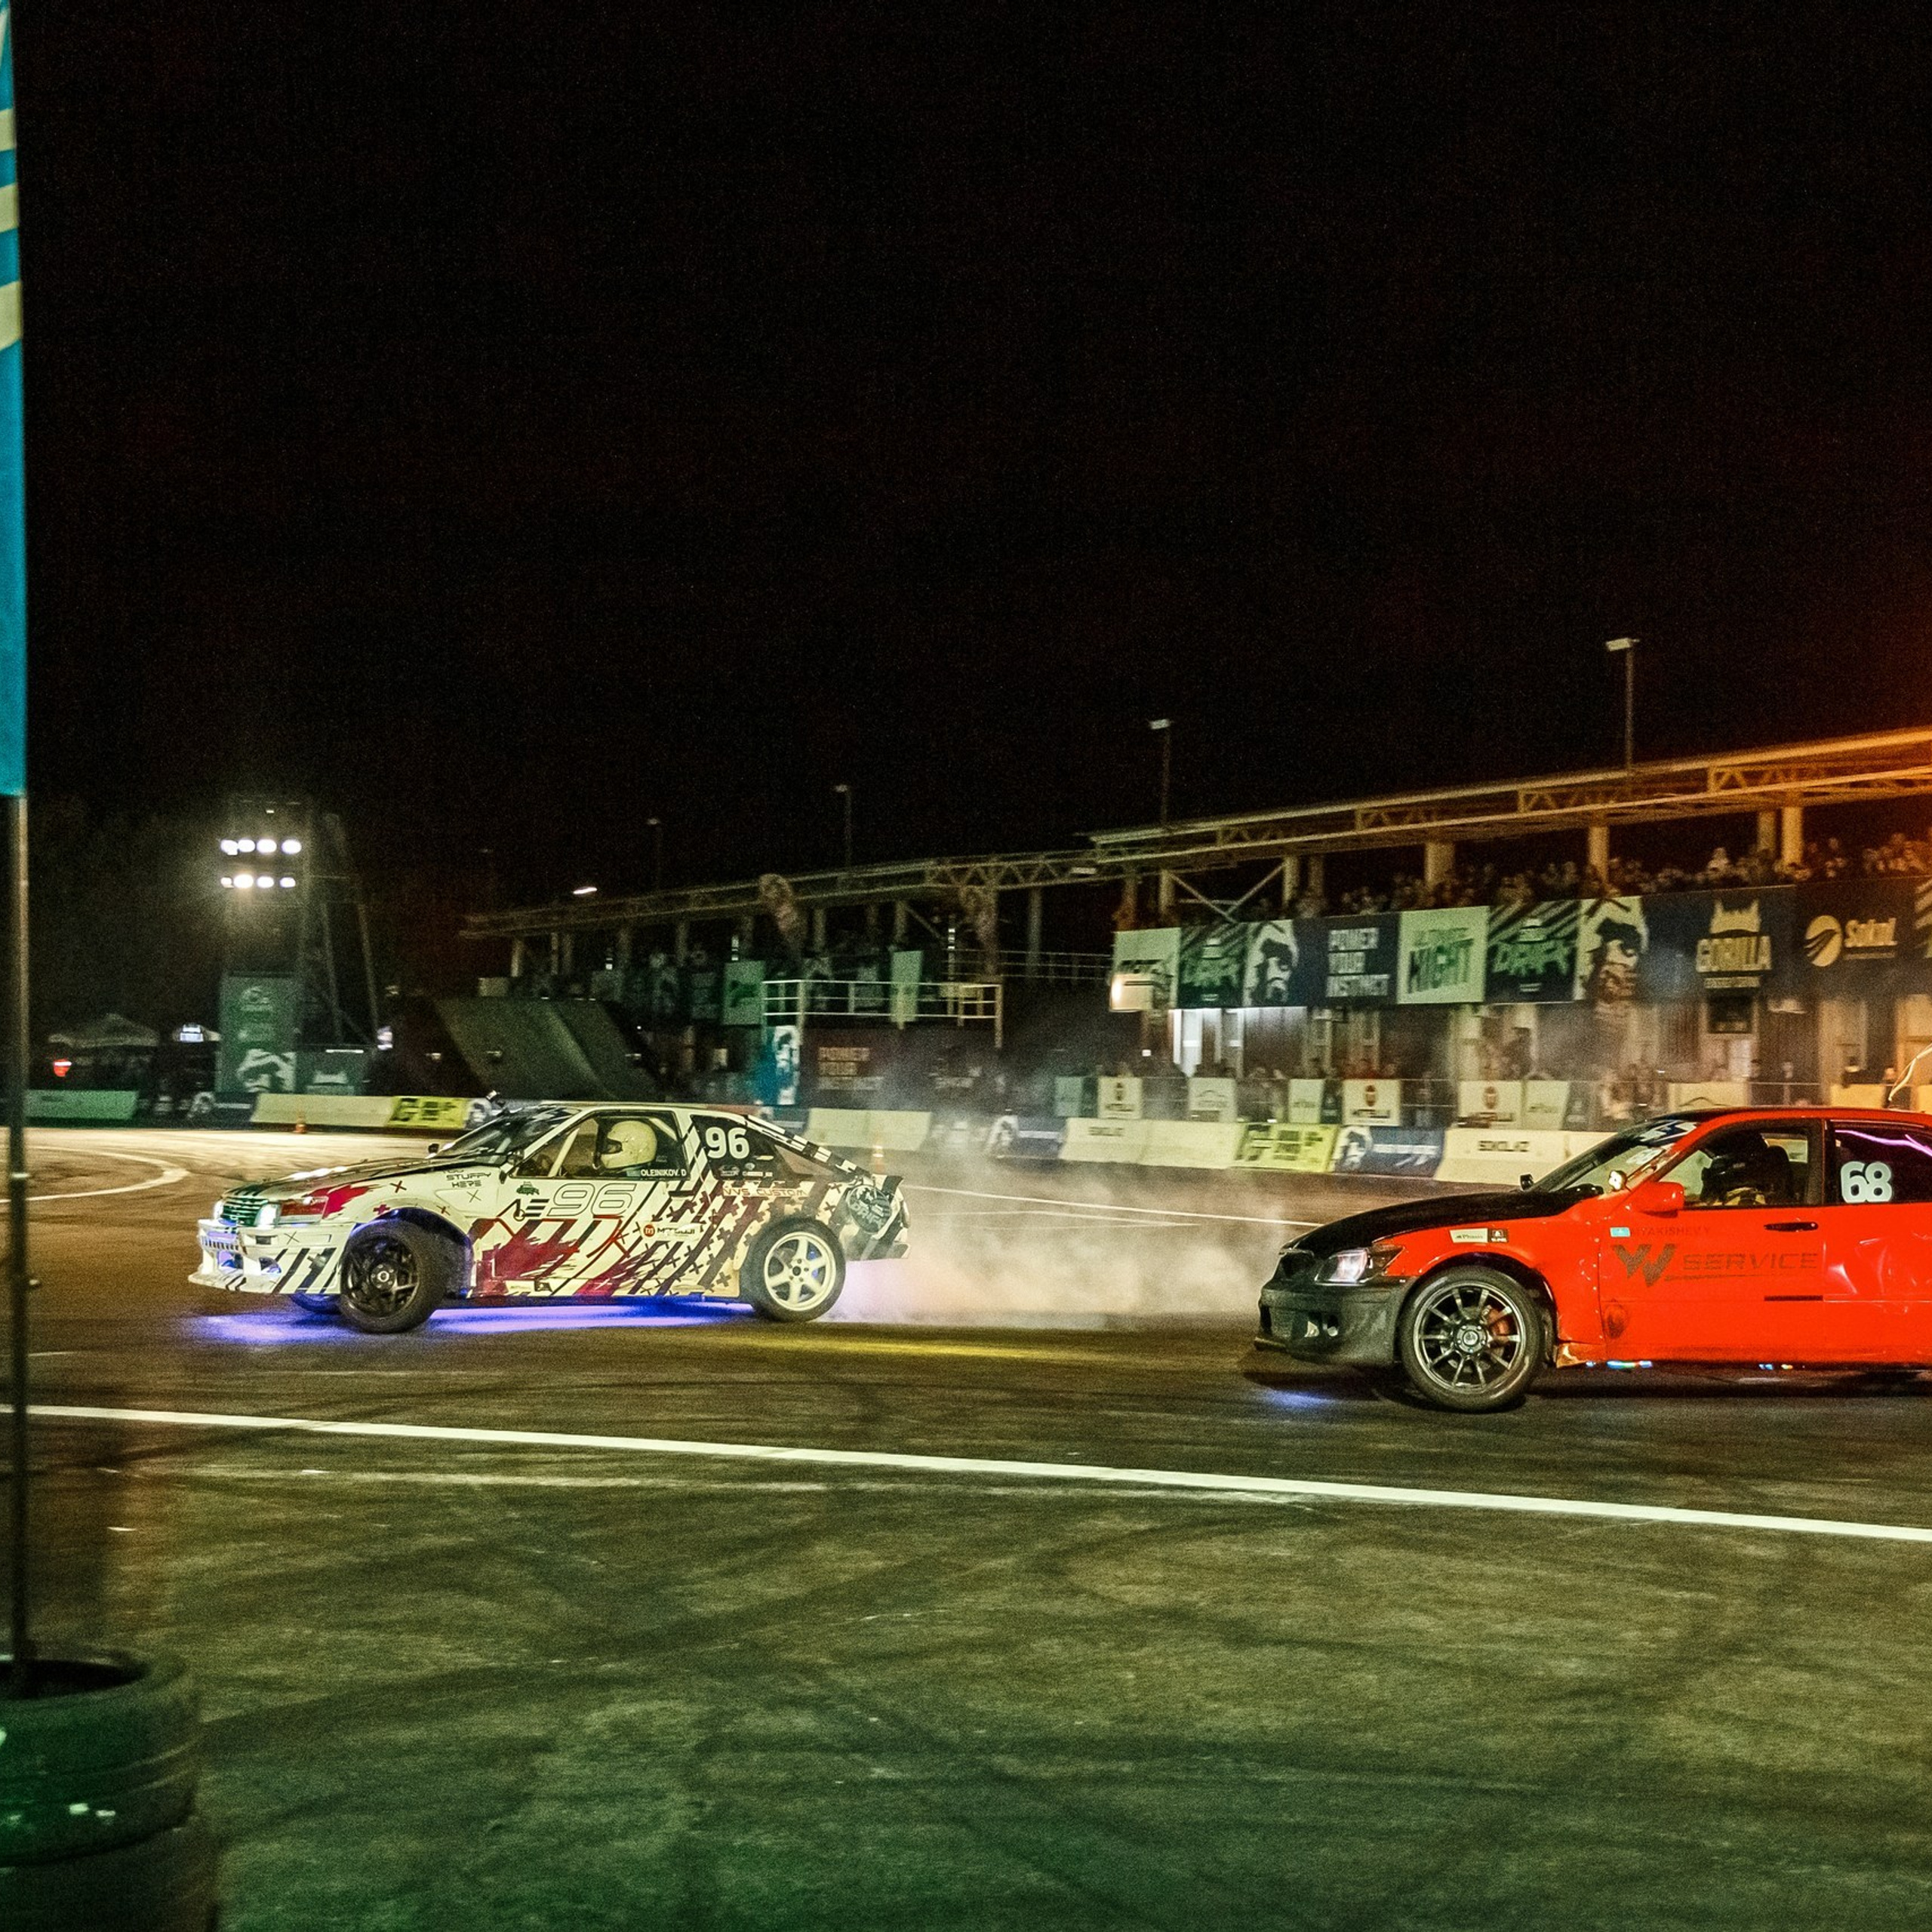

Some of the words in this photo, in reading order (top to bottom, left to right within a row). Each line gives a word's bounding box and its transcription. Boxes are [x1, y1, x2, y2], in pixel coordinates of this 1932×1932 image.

[705, 1126, 750, 1160] 96
[1840, 1161, 1893, 1204] 68
[1682, 1253, 1819, 1271] SERVICE
